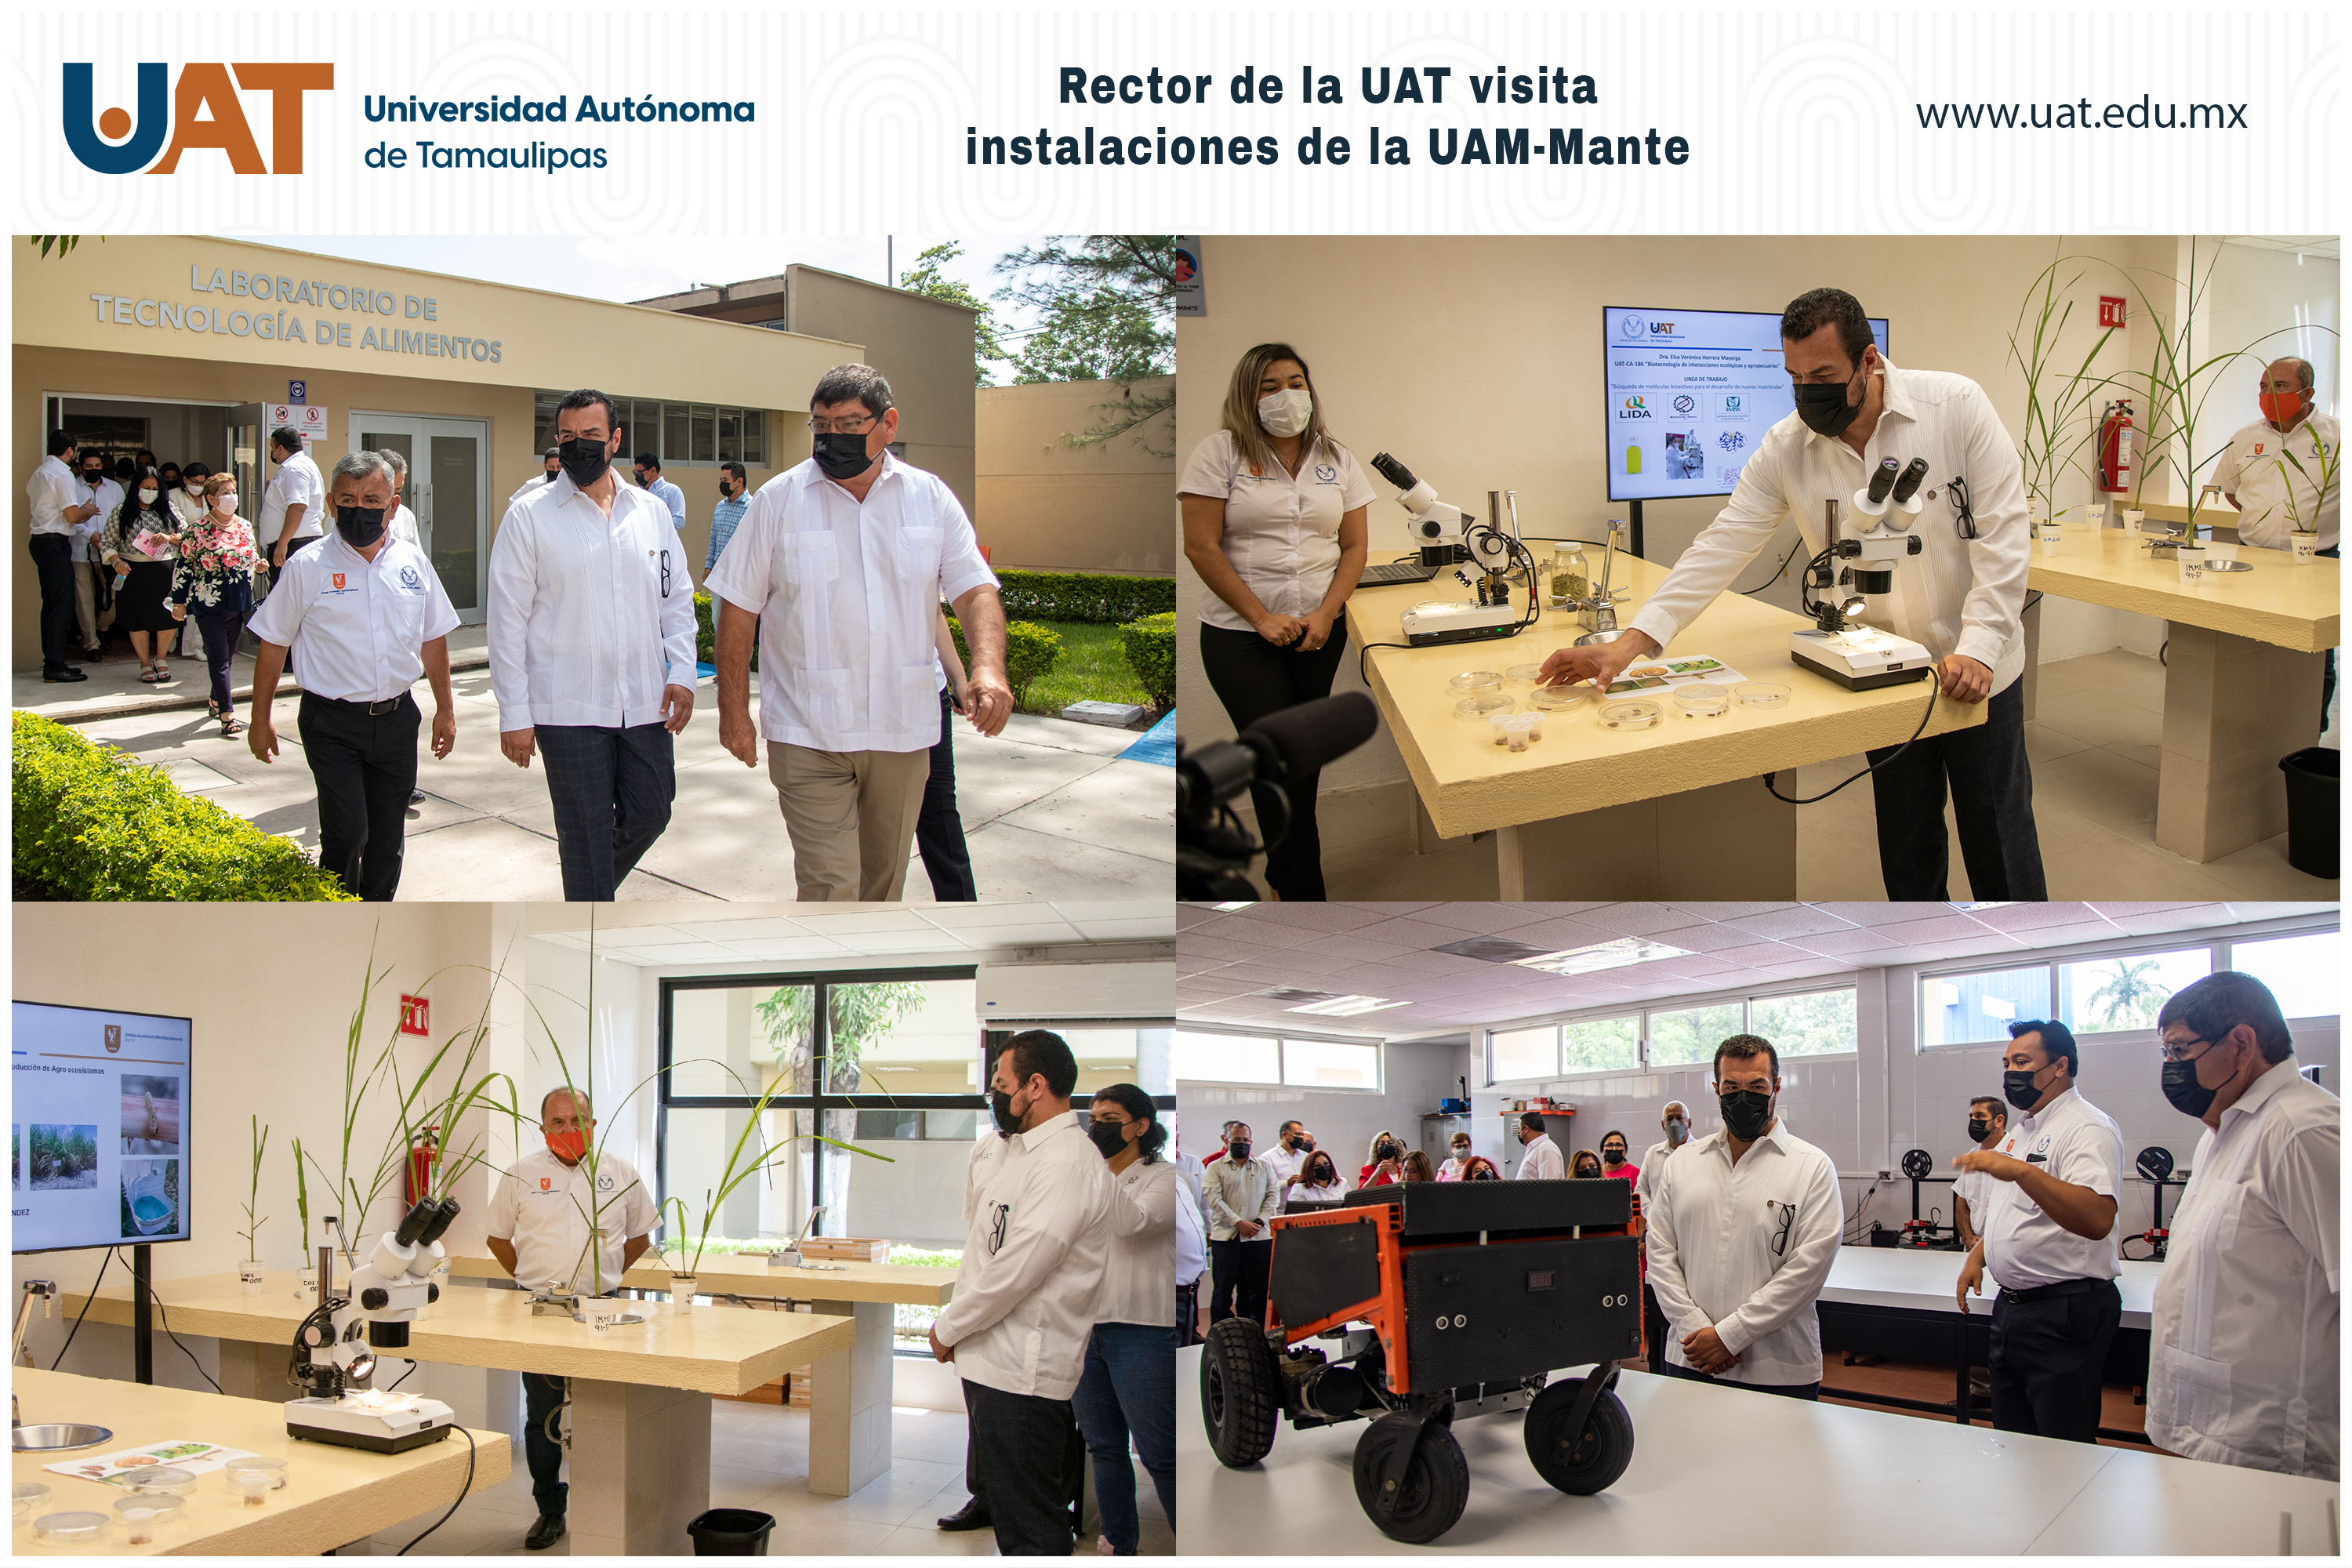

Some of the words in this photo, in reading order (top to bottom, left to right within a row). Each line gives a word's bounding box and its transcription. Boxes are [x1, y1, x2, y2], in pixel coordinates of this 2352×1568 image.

[191, 264, 397, 315] LABORATORIO
[405, 295, 437, 321] DE
[91, 294, 307, 343] TECNOLOGÍA
[316, 320, 352, 347] DE
[360, 326, 502, 363] ALIMENTOS
[1650, 322, 1675, 334] UAT
[1620, 410, 1652, 419] LIDA
[52, 1065, 67, 1074] Agro
[67, 1066, 105, 1075] ecosistemas
